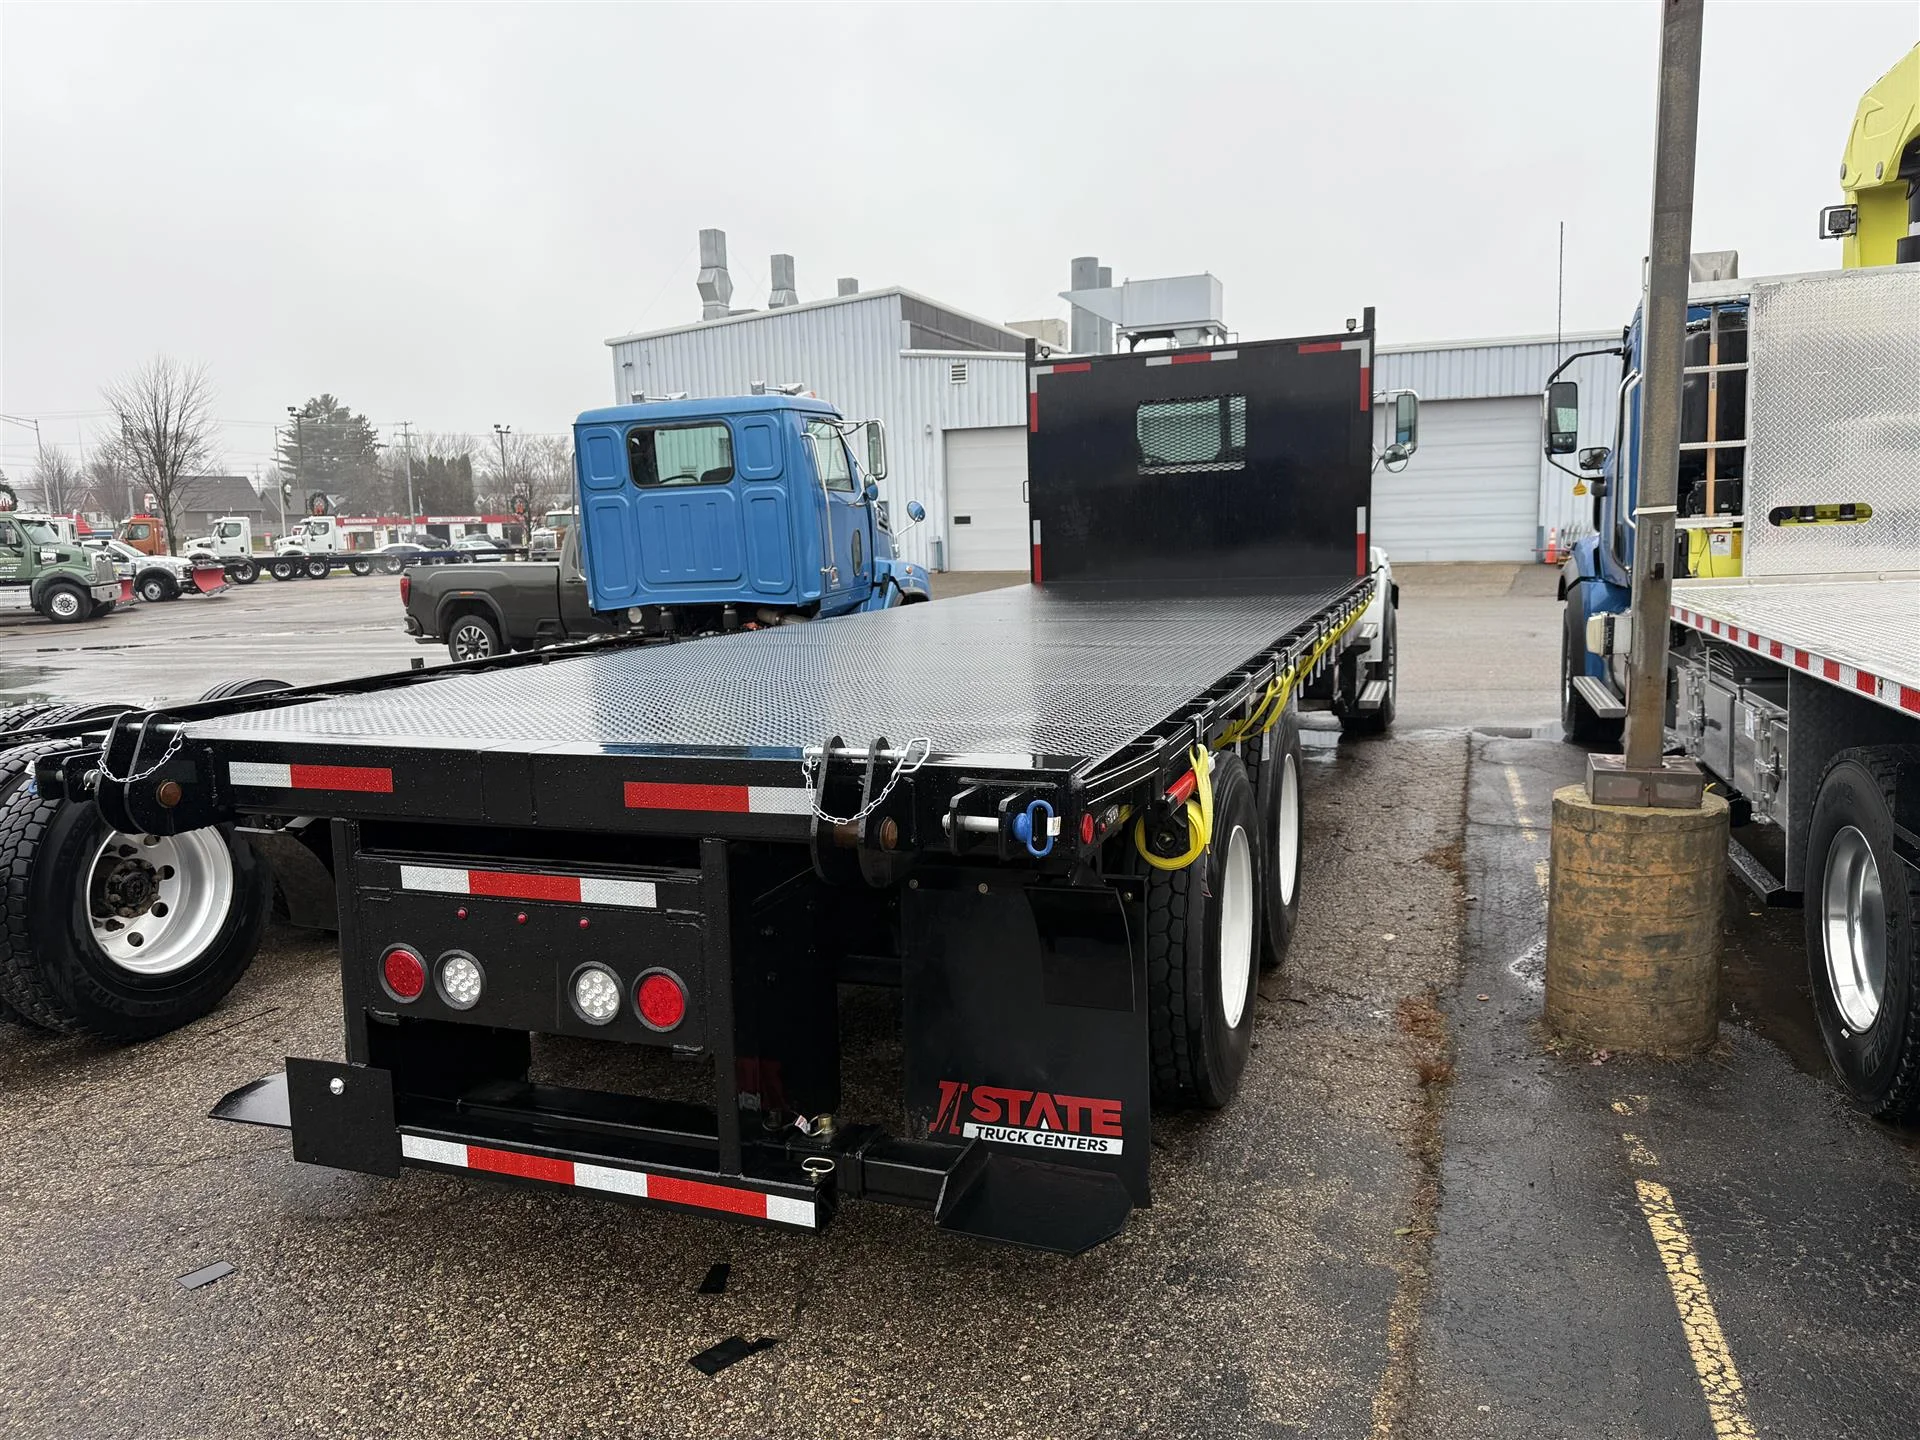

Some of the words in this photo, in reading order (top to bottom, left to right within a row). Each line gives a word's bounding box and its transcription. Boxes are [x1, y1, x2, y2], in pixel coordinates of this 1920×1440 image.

[969, 1085, 1123, 1137] STATE
[975, 1126, 1028, 1144] TRUCK
[1033, 1133, 1108, 1152] CENTERS
